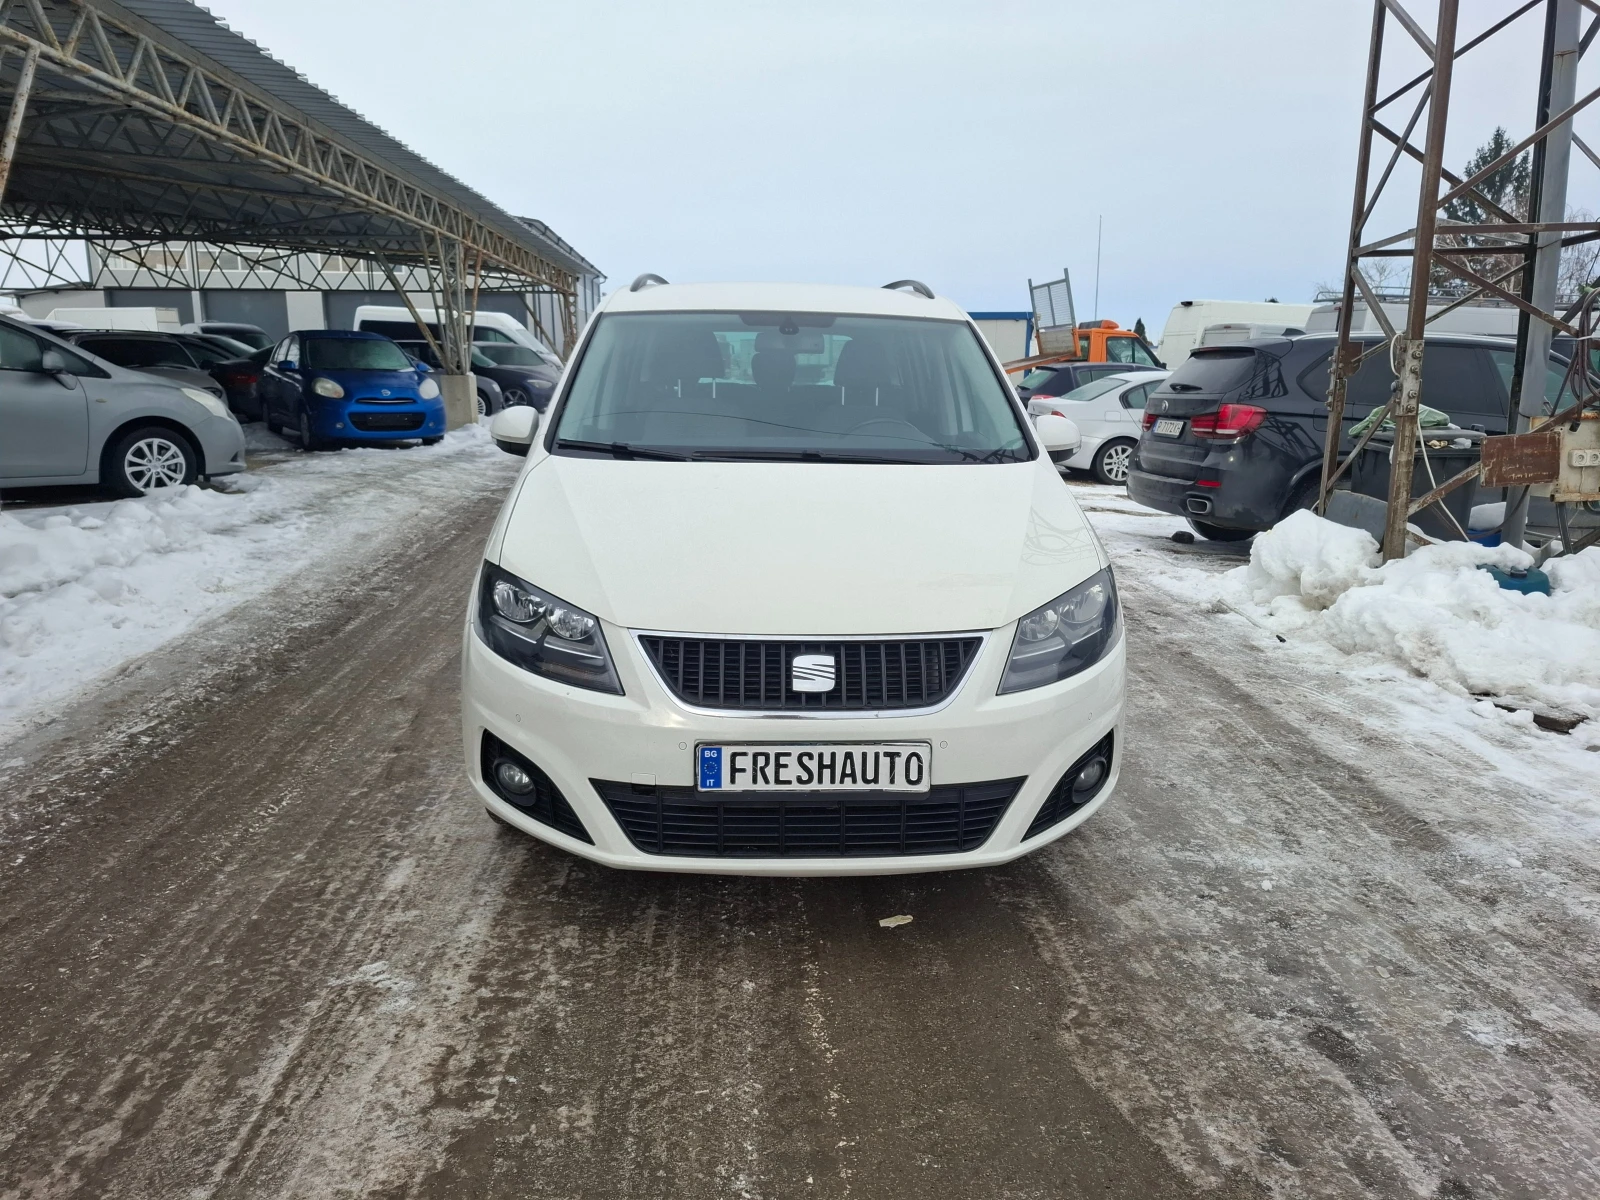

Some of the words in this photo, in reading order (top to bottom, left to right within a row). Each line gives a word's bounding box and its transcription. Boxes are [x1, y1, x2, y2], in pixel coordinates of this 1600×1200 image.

[704, 750, 718, 758] BG
[729, 751, 924, 786] FRESHAUTO
[706, 779, 715, 787] IT
